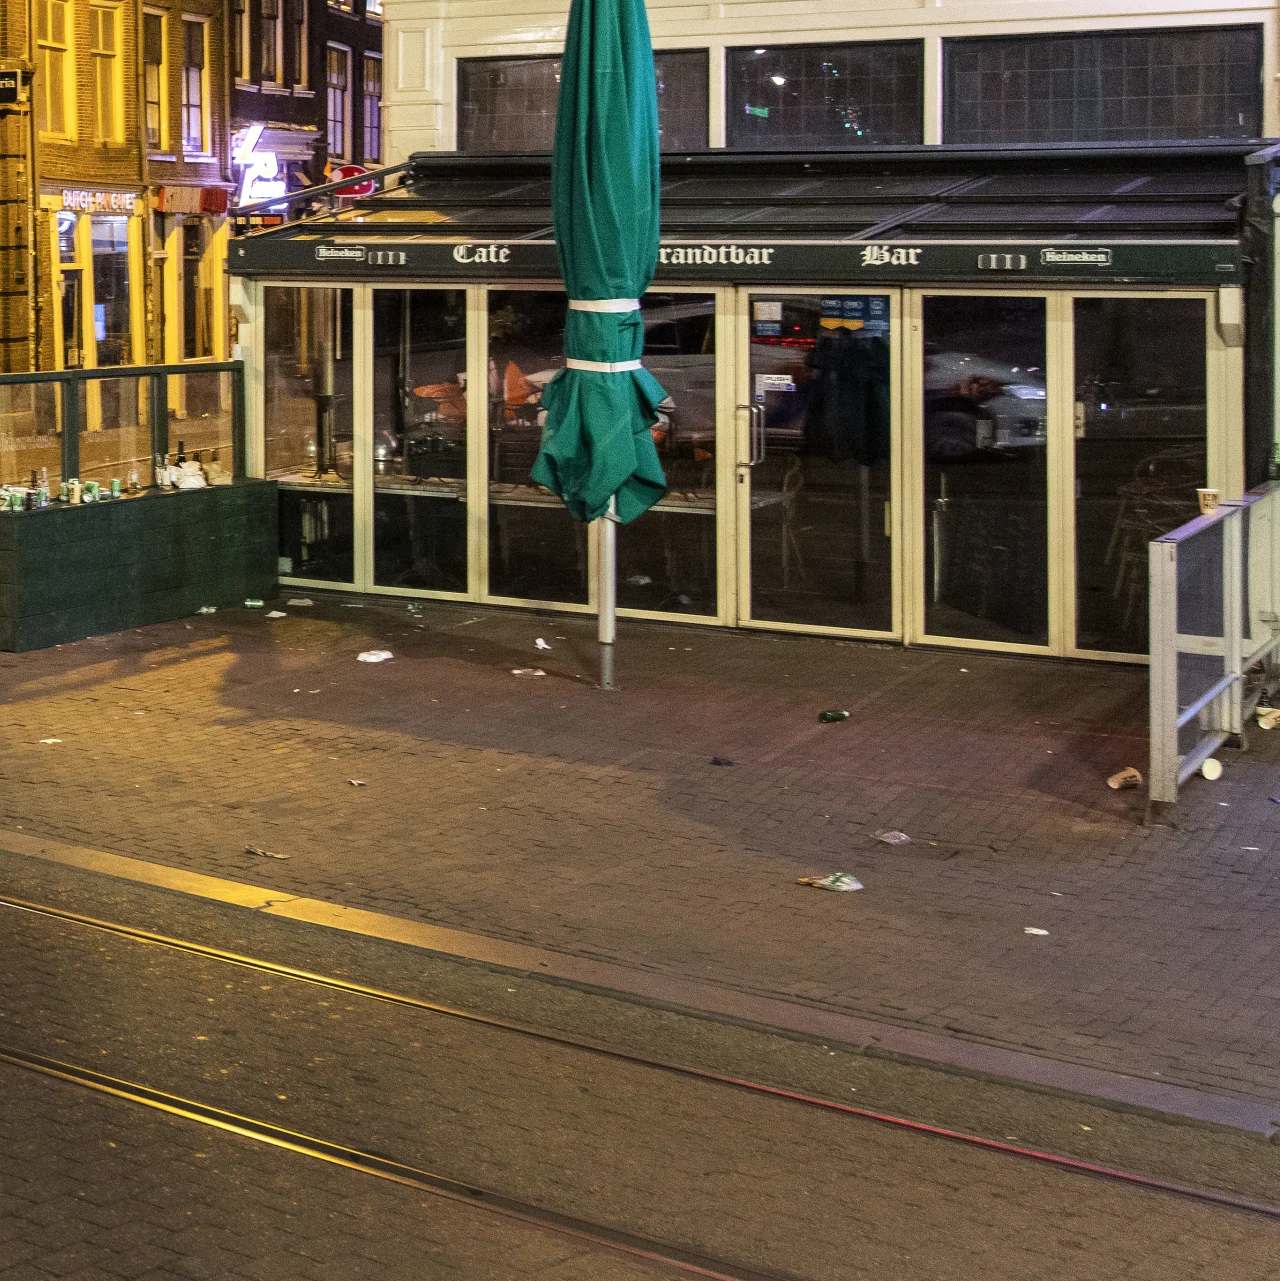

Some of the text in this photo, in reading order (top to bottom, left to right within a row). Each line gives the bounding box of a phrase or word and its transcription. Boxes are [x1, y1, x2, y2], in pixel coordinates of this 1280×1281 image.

[62, 190, 92, 208] DUTCH
[318, 248, 362, 258] Heineken
[453, 244, 923, 267] Café randtbar Bar
[1045, 251, 1107, 262] Heineken
